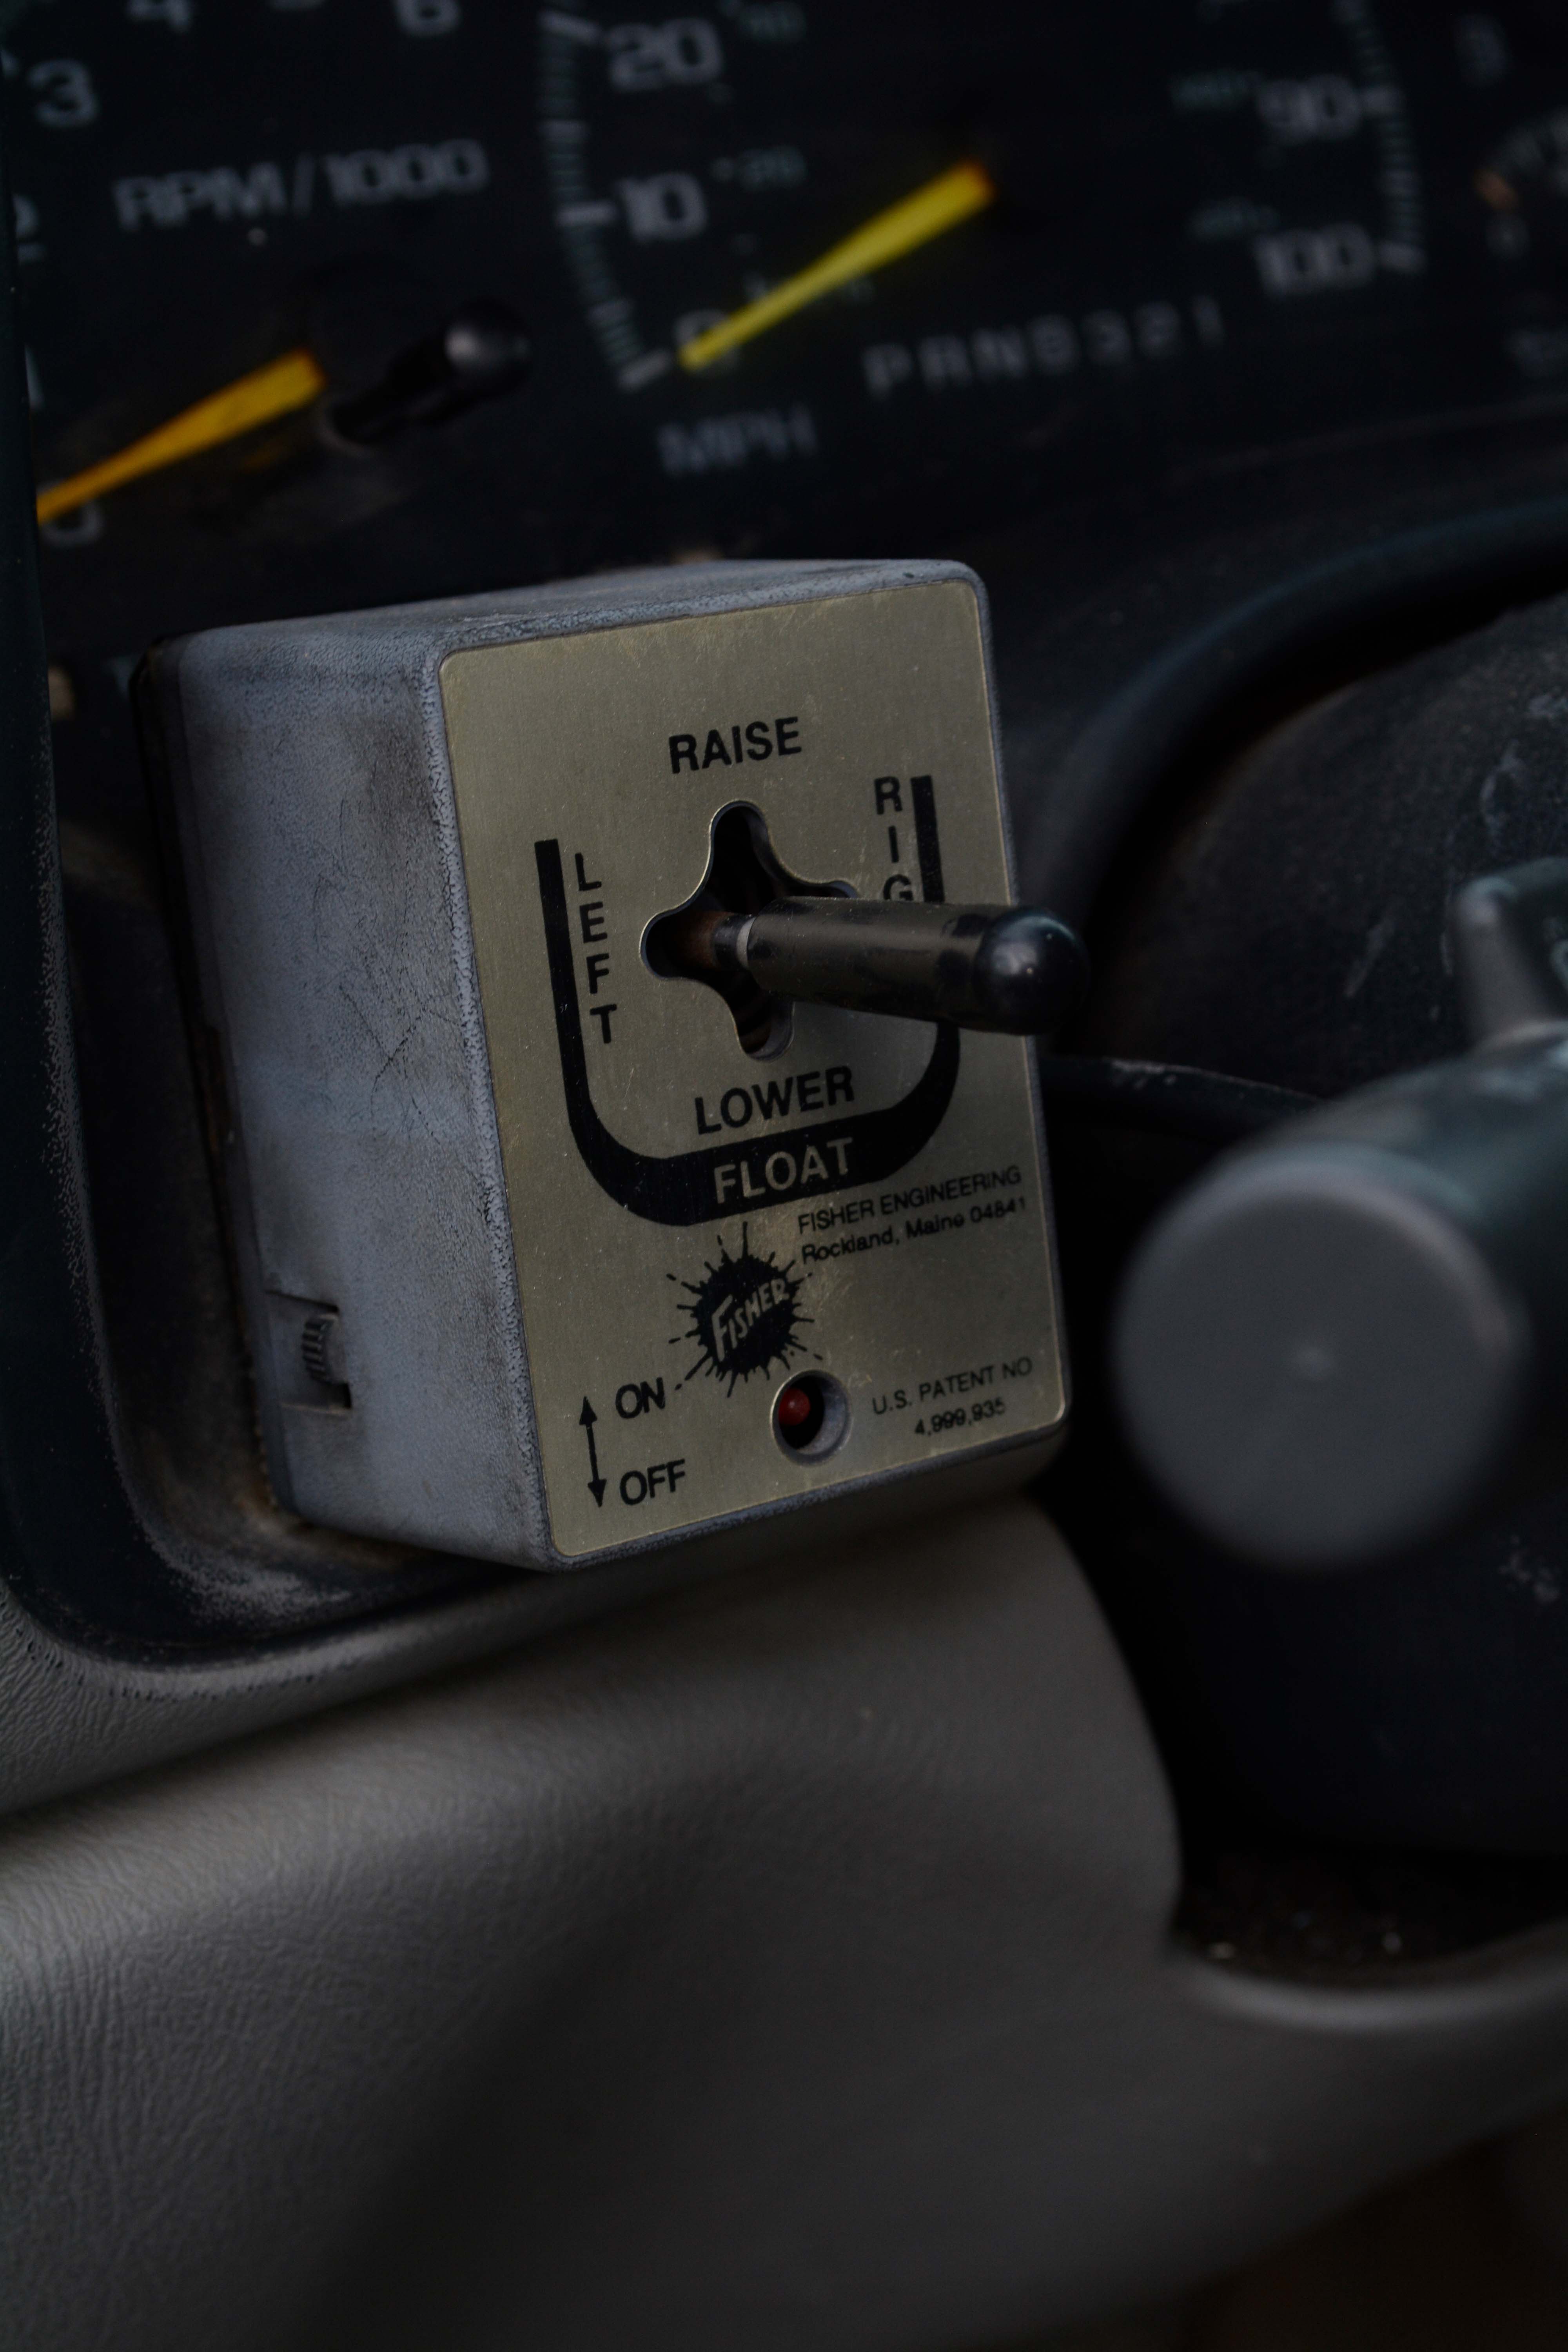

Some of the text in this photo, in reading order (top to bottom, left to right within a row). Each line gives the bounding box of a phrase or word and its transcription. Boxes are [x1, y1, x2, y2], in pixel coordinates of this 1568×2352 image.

[604, 16, 725, 93] 20
[25, 58, 101, 129] 3
[1256, 74, 1362, 147] 90
[112, 138, 491, 232] RPM/1000
[615, 171, 708, 244] 10
[1250, 222, 1378, 302] 100
[657, 404, 818, 476] MPH
[669, 717, 802, 774] RAISE
[874, 775, 914, 901] RIG
[575, 853, 617, 1044] LEFT
[695, 1066, 855, 1134] LOWER
[714, 1137, 854, 1205] FLOAT
[798, 1165, 1022, 1234] FISHER ENGINEERING
[802, 1197, 1026, 1264] Rockland, Maine 04841
[711, 1278, 790, 1363] FISHER
[615, 1377, 665, 1419] ON
[872, 1357, 1033, 1415] U.S. PATENT NO
[620, 1459, 685, 1505] OFF
